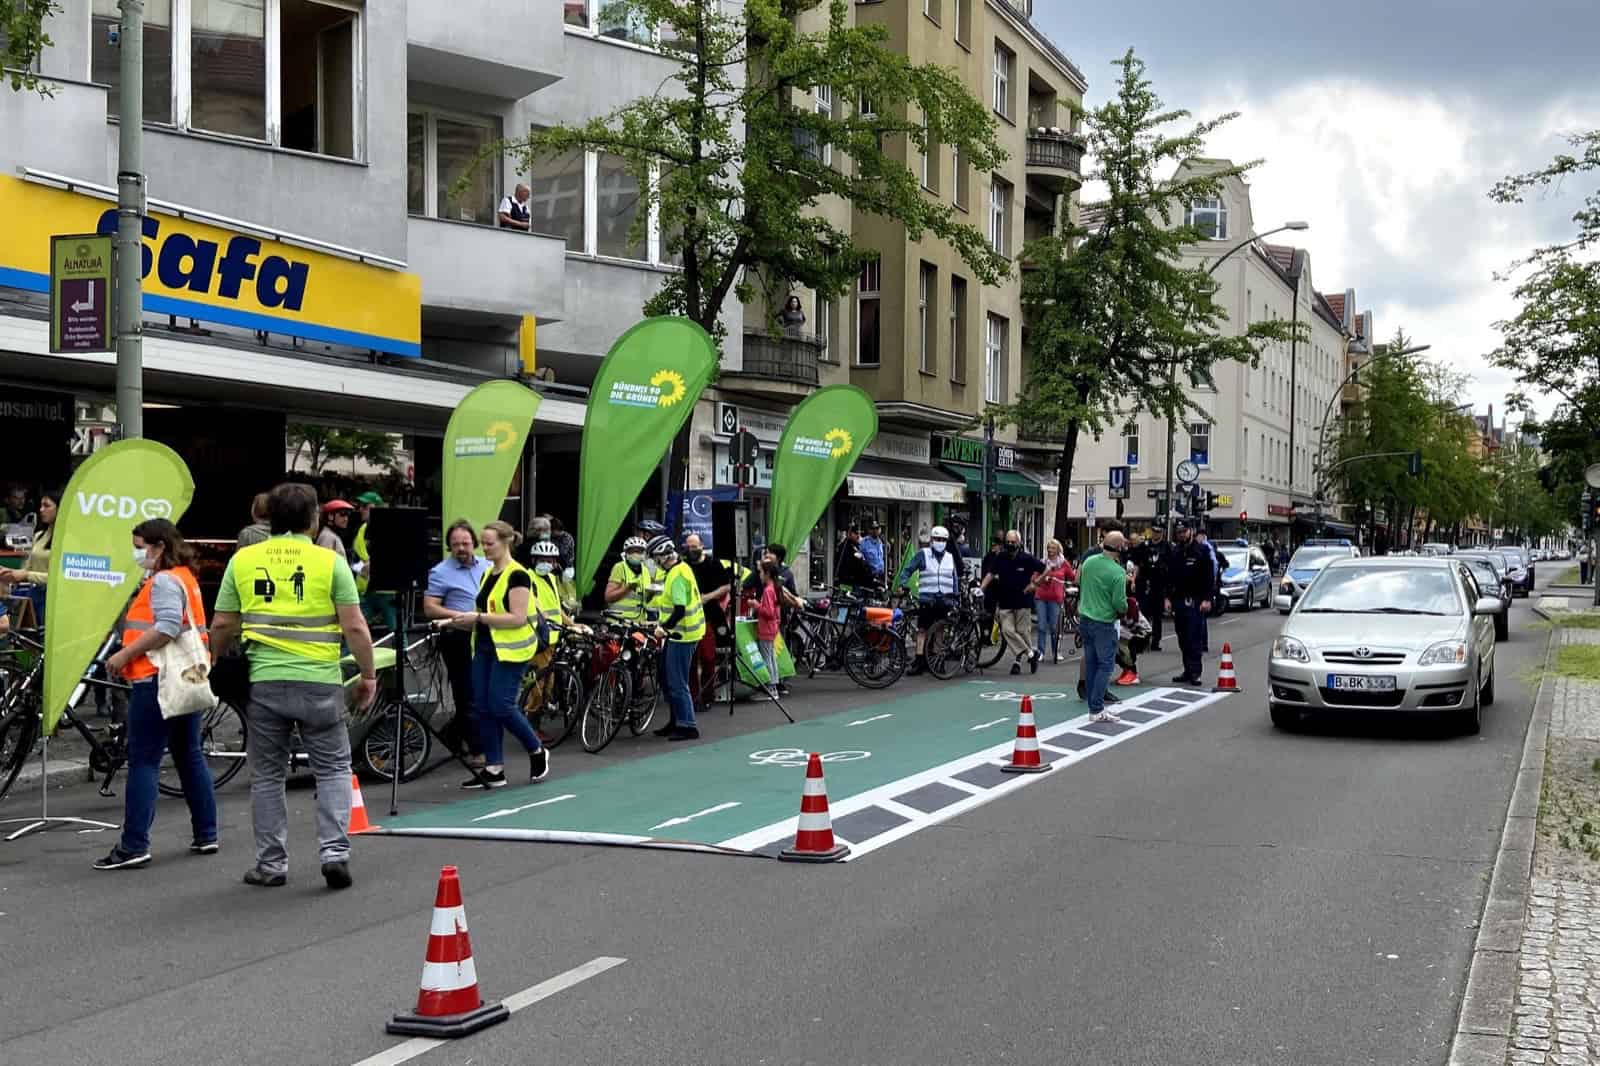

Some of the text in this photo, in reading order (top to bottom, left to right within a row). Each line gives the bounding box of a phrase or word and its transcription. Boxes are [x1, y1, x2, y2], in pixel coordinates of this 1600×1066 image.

[1111, 469, 1123, 488] U
[76, 491, 137, 519] VCD
[66, 556, 107, 570] Mobilität
